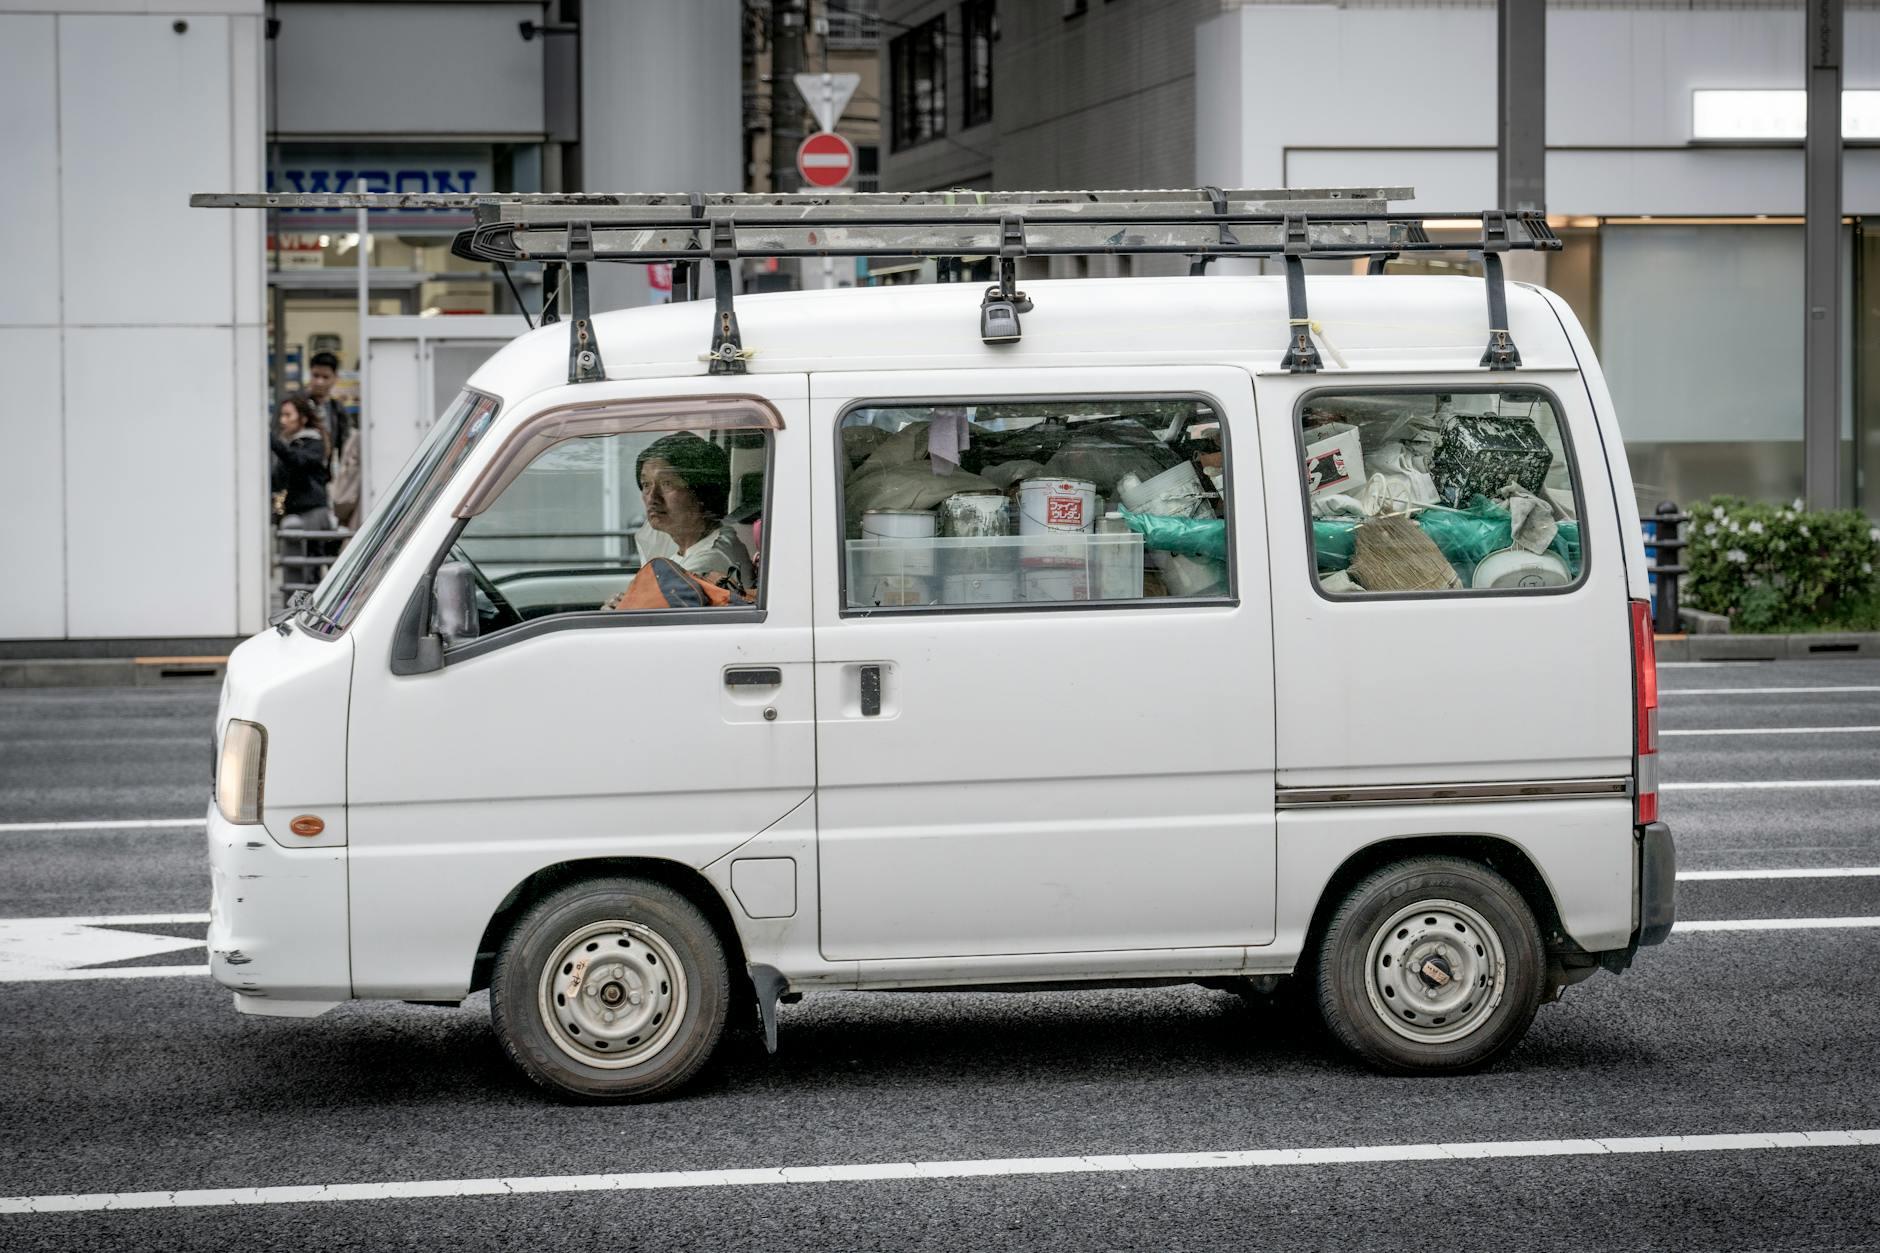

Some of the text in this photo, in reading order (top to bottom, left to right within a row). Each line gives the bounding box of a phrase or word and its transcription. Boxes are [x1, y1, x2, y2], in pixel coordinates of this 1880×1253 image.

[267, 170, 476, 212] WSON
[1050, 501, 1078, 511] ファイン
[1052, 510, 1081, 520] ウレタン
